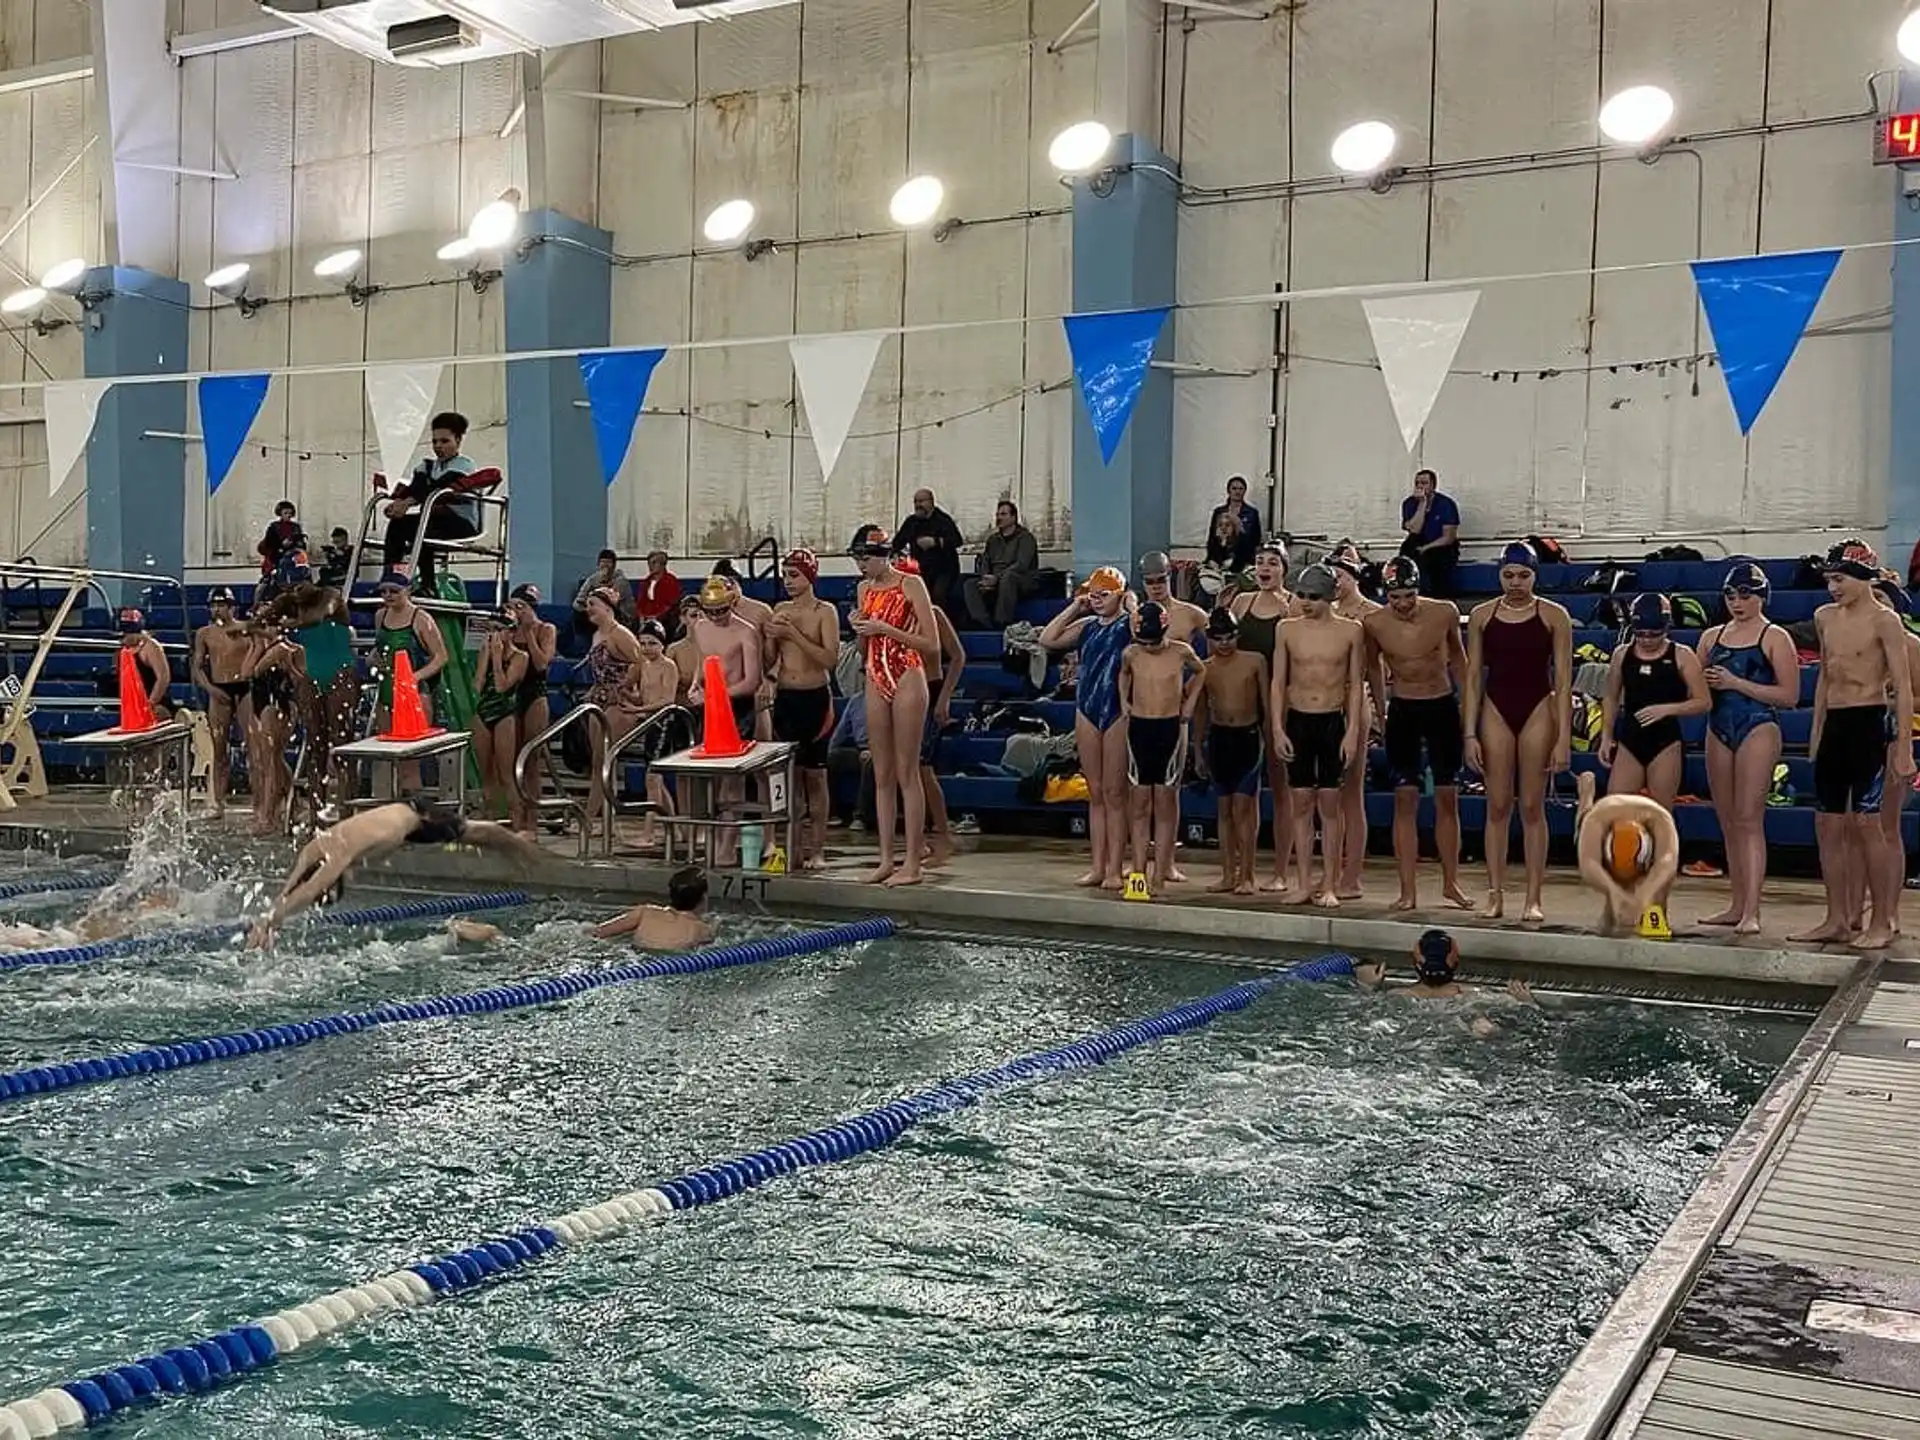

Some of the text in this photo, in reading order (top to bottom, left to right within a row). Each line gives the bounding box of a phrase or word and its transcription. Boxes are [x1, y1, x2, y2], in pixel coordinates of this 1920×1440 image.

[1893, 118, 1919, 153] 4
[775, 785, 784, 800] 2
[721, 875, 771, 899] 7 FT
[1131, 879, 1145, 893] 10
[1649, 911, 1660, 927] 9
